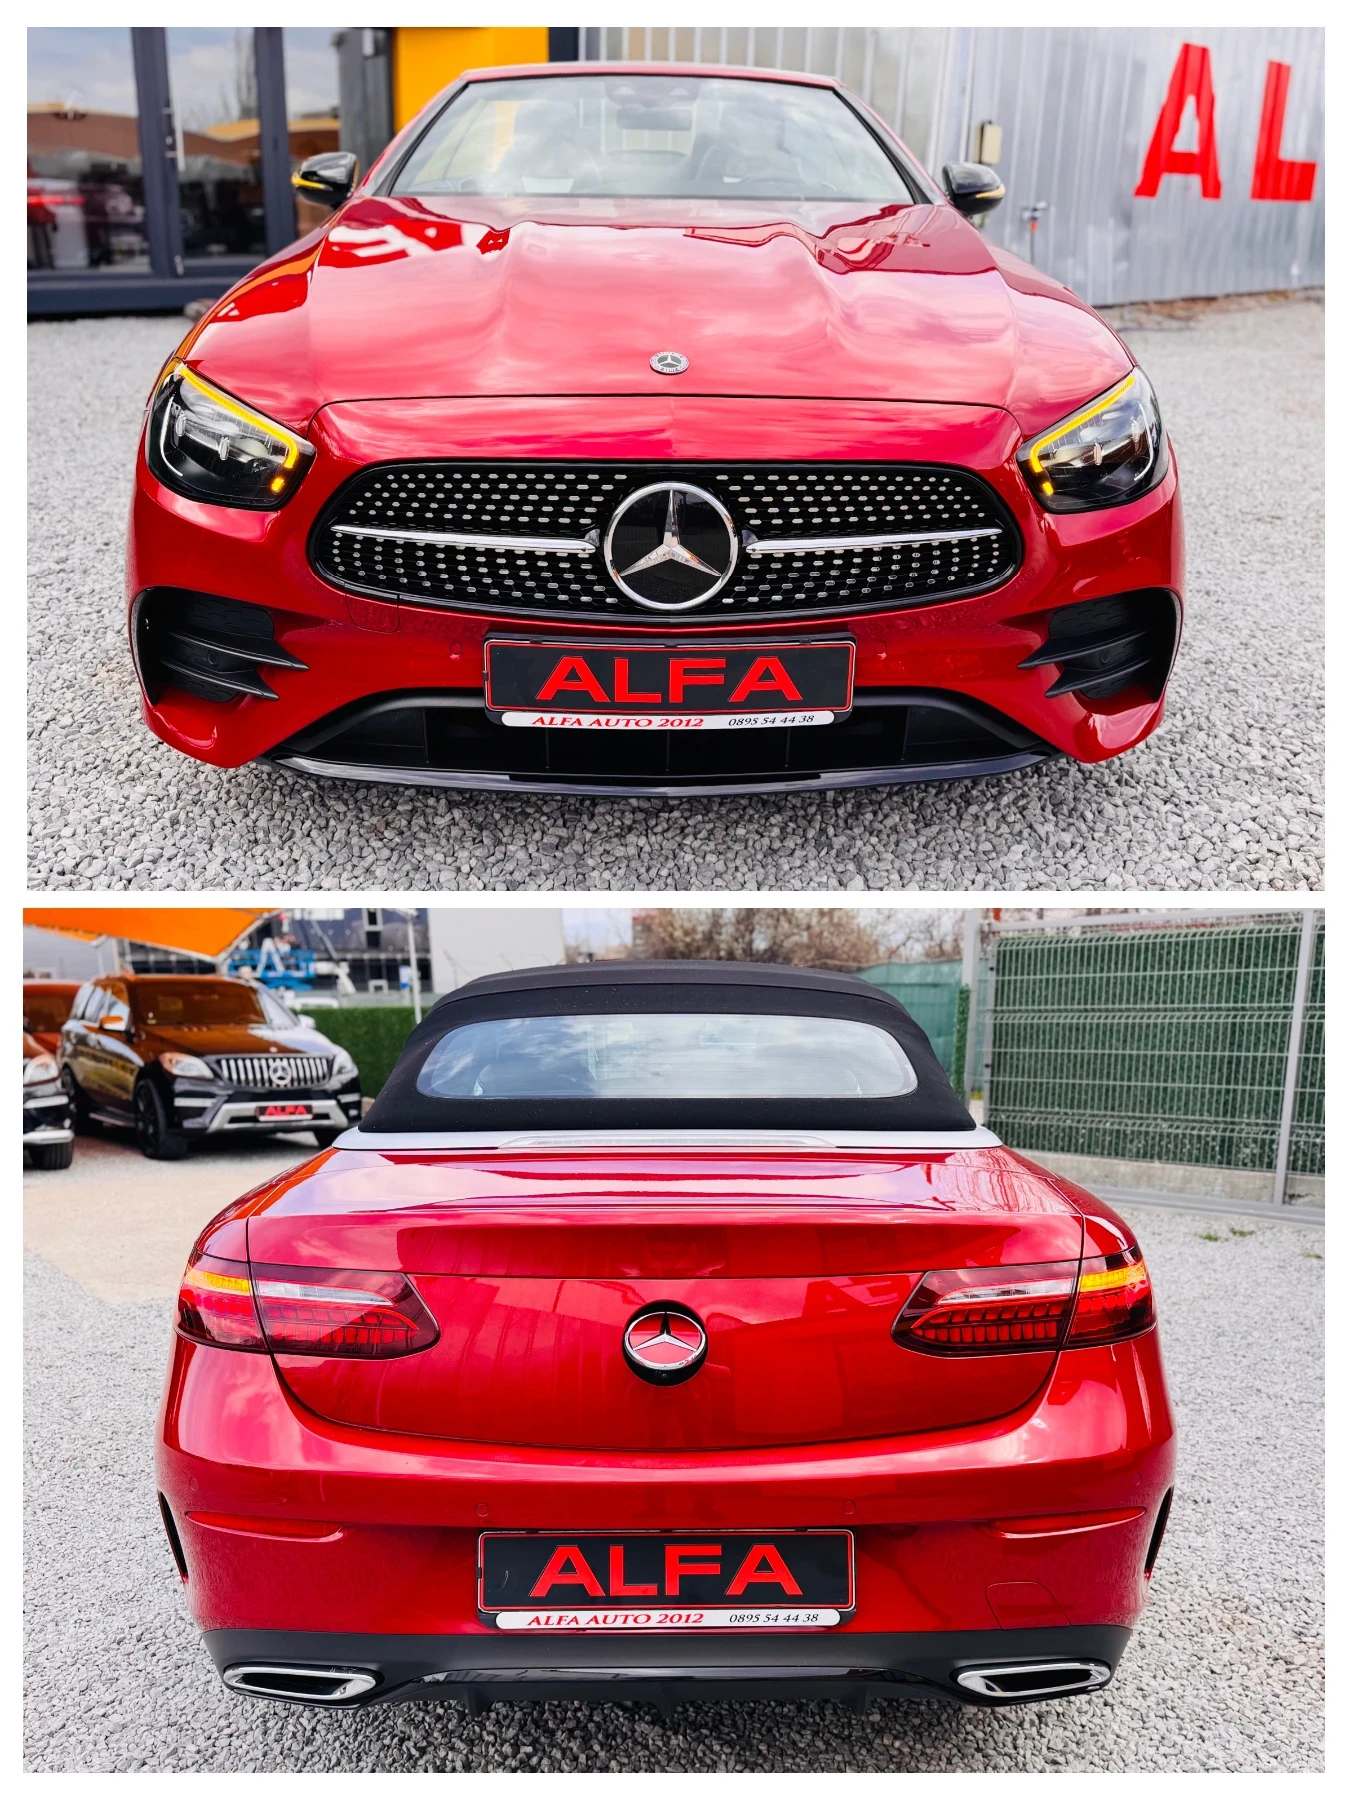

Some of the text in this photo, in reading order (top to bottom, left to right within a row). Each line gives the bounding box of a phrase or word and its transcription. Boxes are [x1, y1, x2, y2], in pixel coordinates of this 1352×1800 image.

[1134, 42, 1318, 203] AL
[536, 655, 804, 704] ALFA
[531, 716, 705, 728] ALFA AUTO 2012
[728, 714, 815, 726] 0895 54 44 38
[265, 1104, 307, 1117] ALFA
[528, 1543, 804, 1598] ALFA
[526, 1612, 705, 1627] ALFA AUTO 2012
[729, 1613, 819, 1623] 0895 54 44 38
